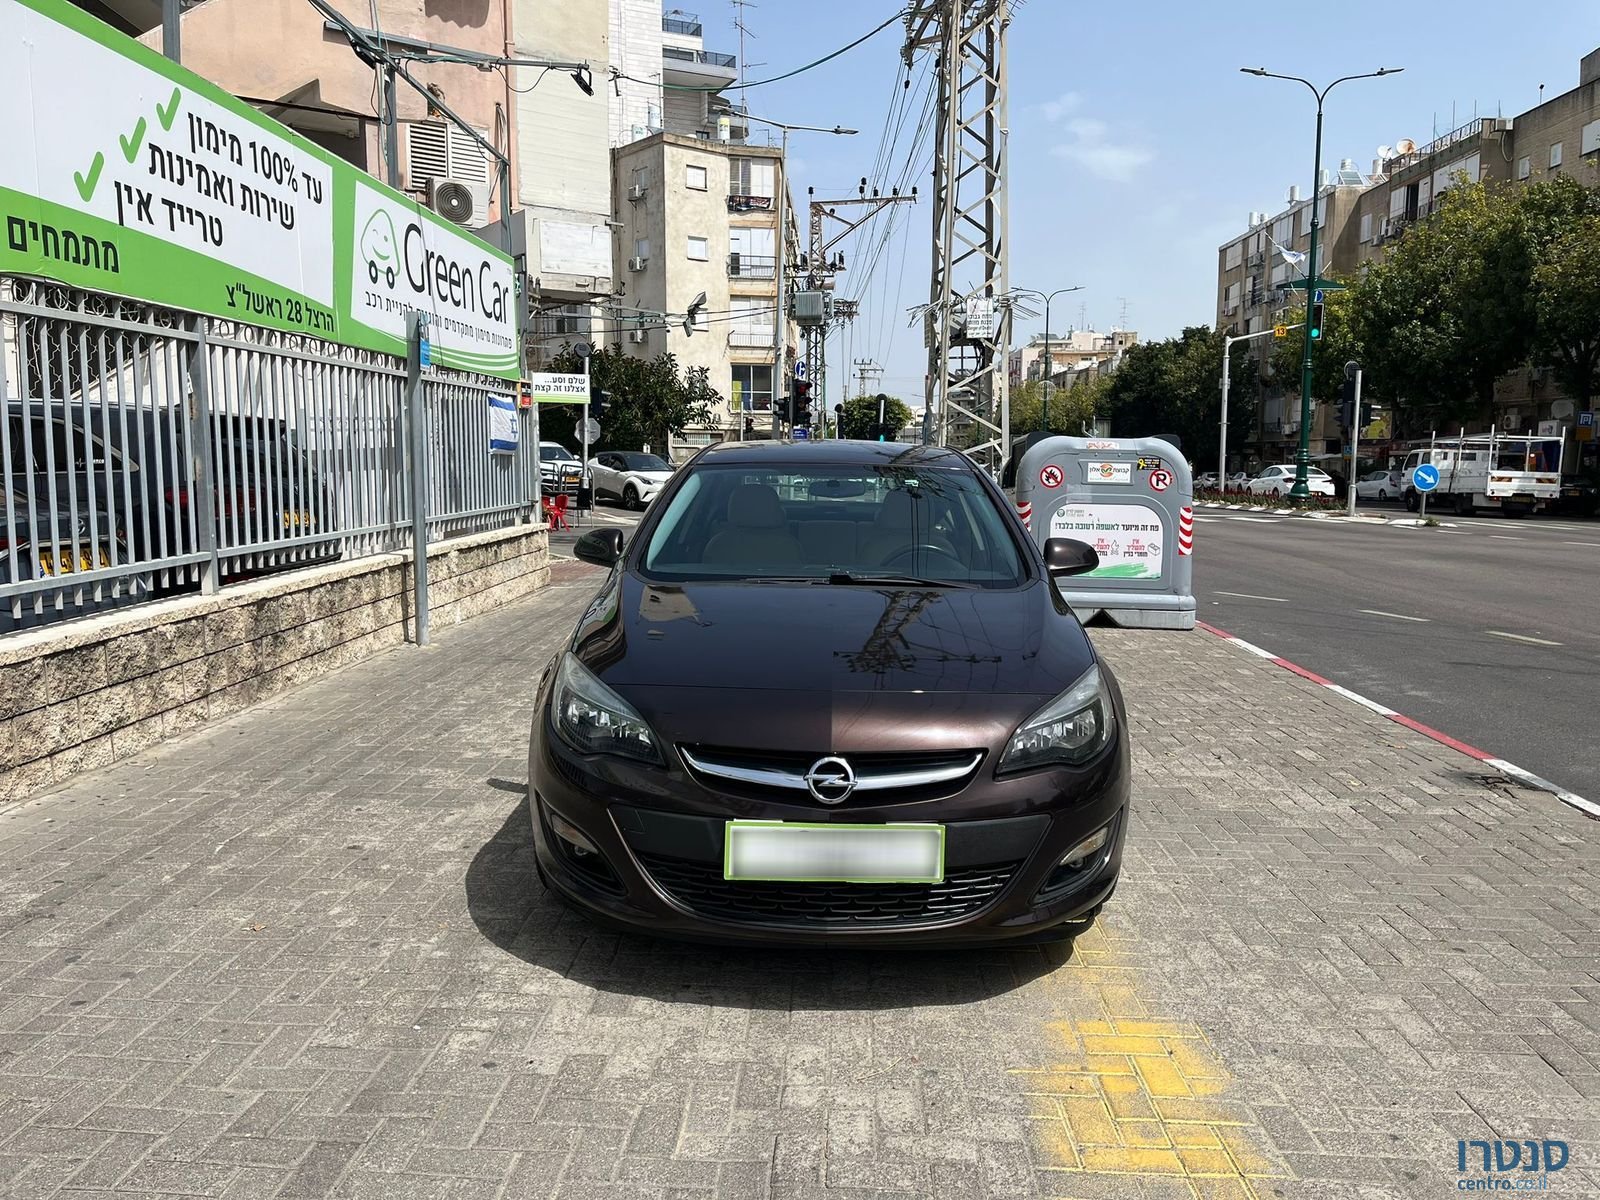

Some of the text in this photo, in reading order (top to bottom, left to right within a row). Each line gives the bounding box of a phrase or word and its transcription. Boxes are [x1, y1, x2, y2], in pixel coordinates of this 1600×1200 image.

[187, 112, 323, 205] עד 100% מימון
[148, 143, 295, 230] שירות ואמינות
[114, 181, 224, 247] טרייד אין
[6, 215, 120, 273] מתמחים
[404, 223, 509, 324] Green Car
[286, 298, 303, 324] 28
[365, 290, 383, 310] רכב
[304, 306, 335, 333] הרצל
[444, 316, 474, 339] מתקדמים
[475, 327, 490, 343] מימון
[534, 384, 551, 393] קצת
[564, 385, 585, 393] אצלנו
[568, 376, 585, 385] שלם
[1096, 522, 1120, 531] לאשפה
